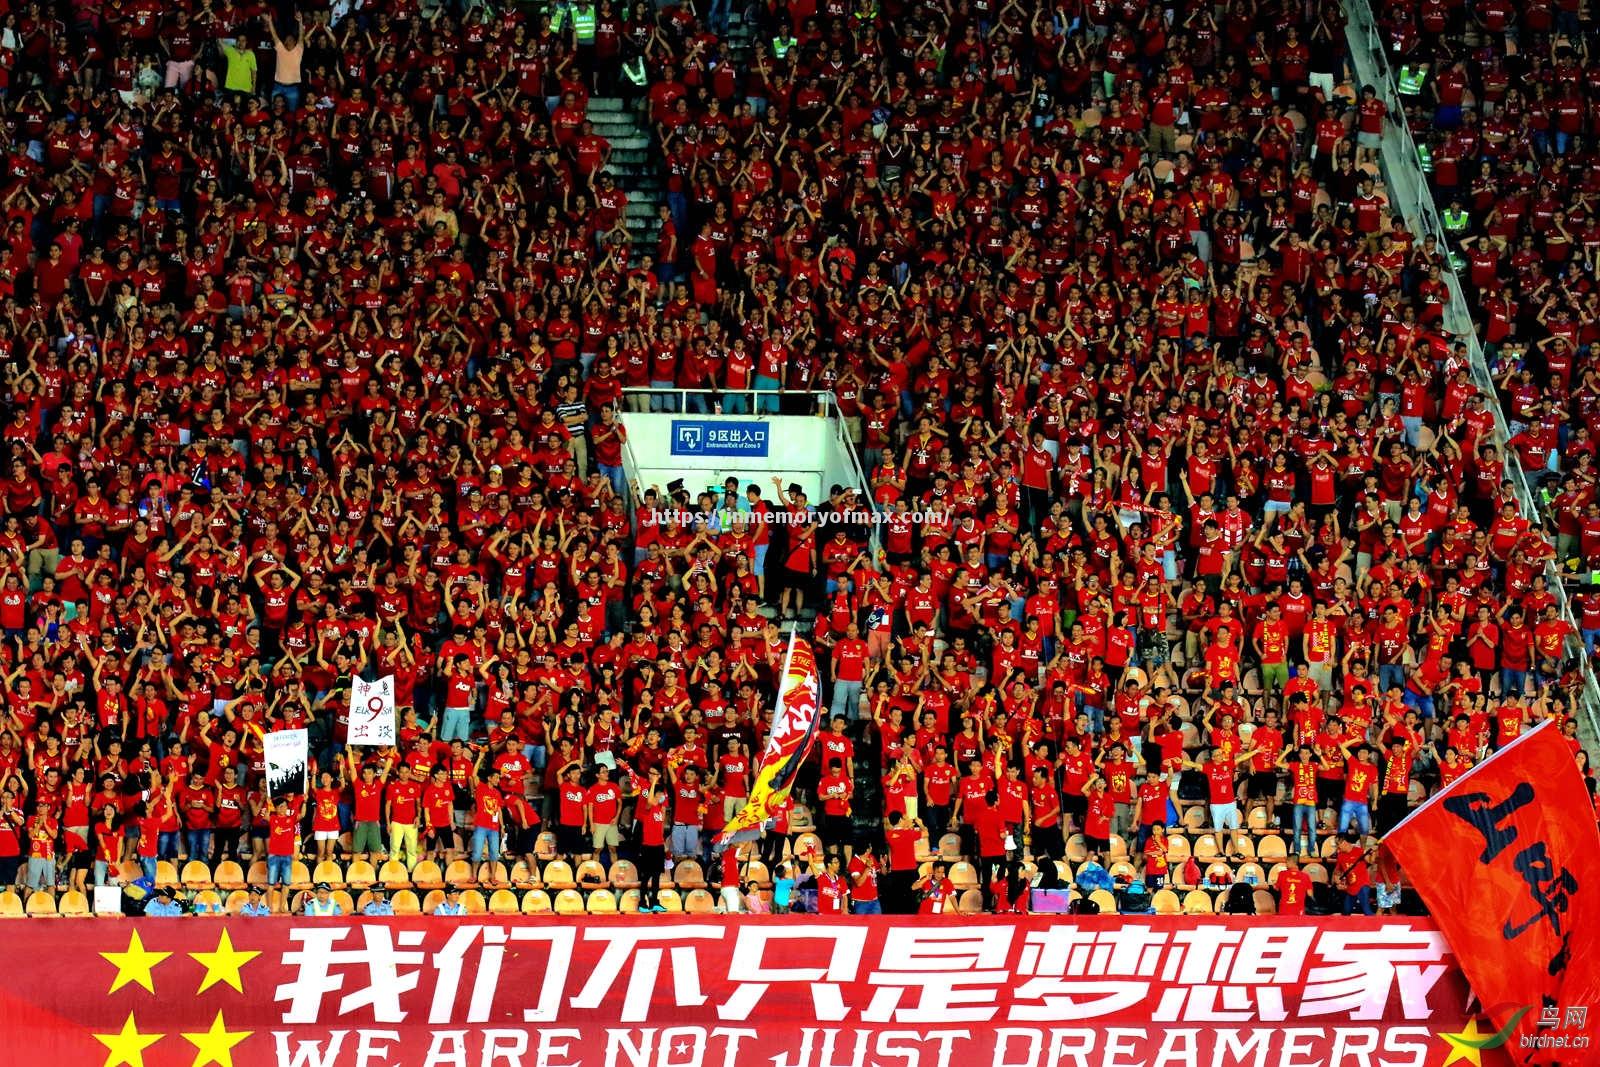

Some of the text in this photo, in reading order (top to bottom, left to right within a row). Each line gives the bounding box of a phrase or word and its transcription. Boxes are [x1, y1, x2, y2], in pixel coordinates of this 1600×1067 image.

[708, 430, 765, 442] 9区出入口
[367, 697, 383, 722] 9
[274, 925, 1451, 1024] 我们不只是梦想家
[271, 1026, 1431, 1067] WE ARE NOT JUST DREAMERS
